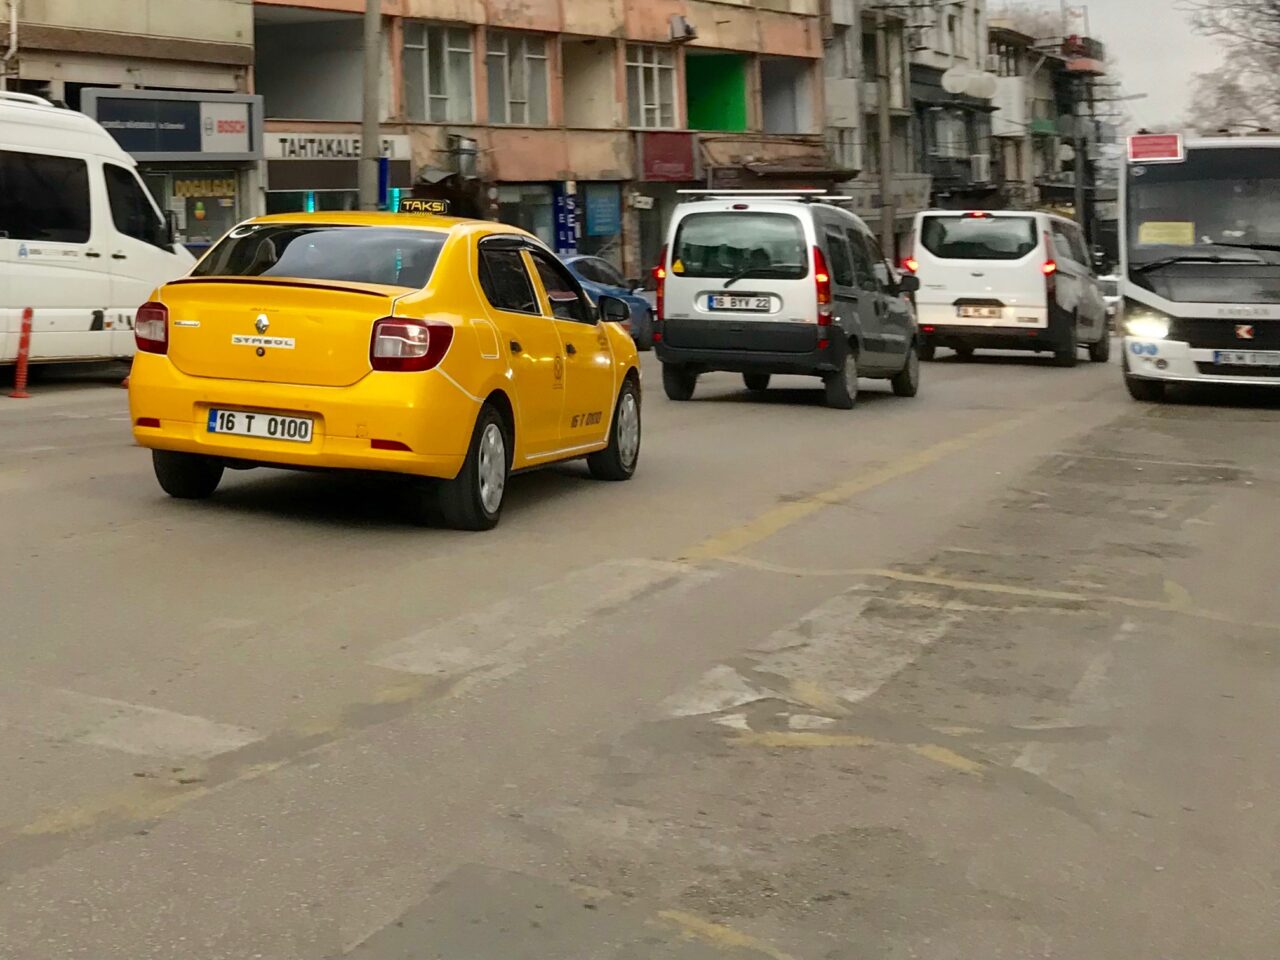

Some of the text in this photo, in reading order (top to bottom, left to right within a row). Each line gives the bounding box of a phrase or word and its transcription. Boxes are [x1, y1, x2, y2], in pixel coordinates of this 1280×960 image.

[217, 119, 245, 134] BOSCH
[279, 138, 361, 158] TAHTAKALE
[233, 336, 294, 347] SYMBOL
[219, 412, 310, 440] 16 T 0100
